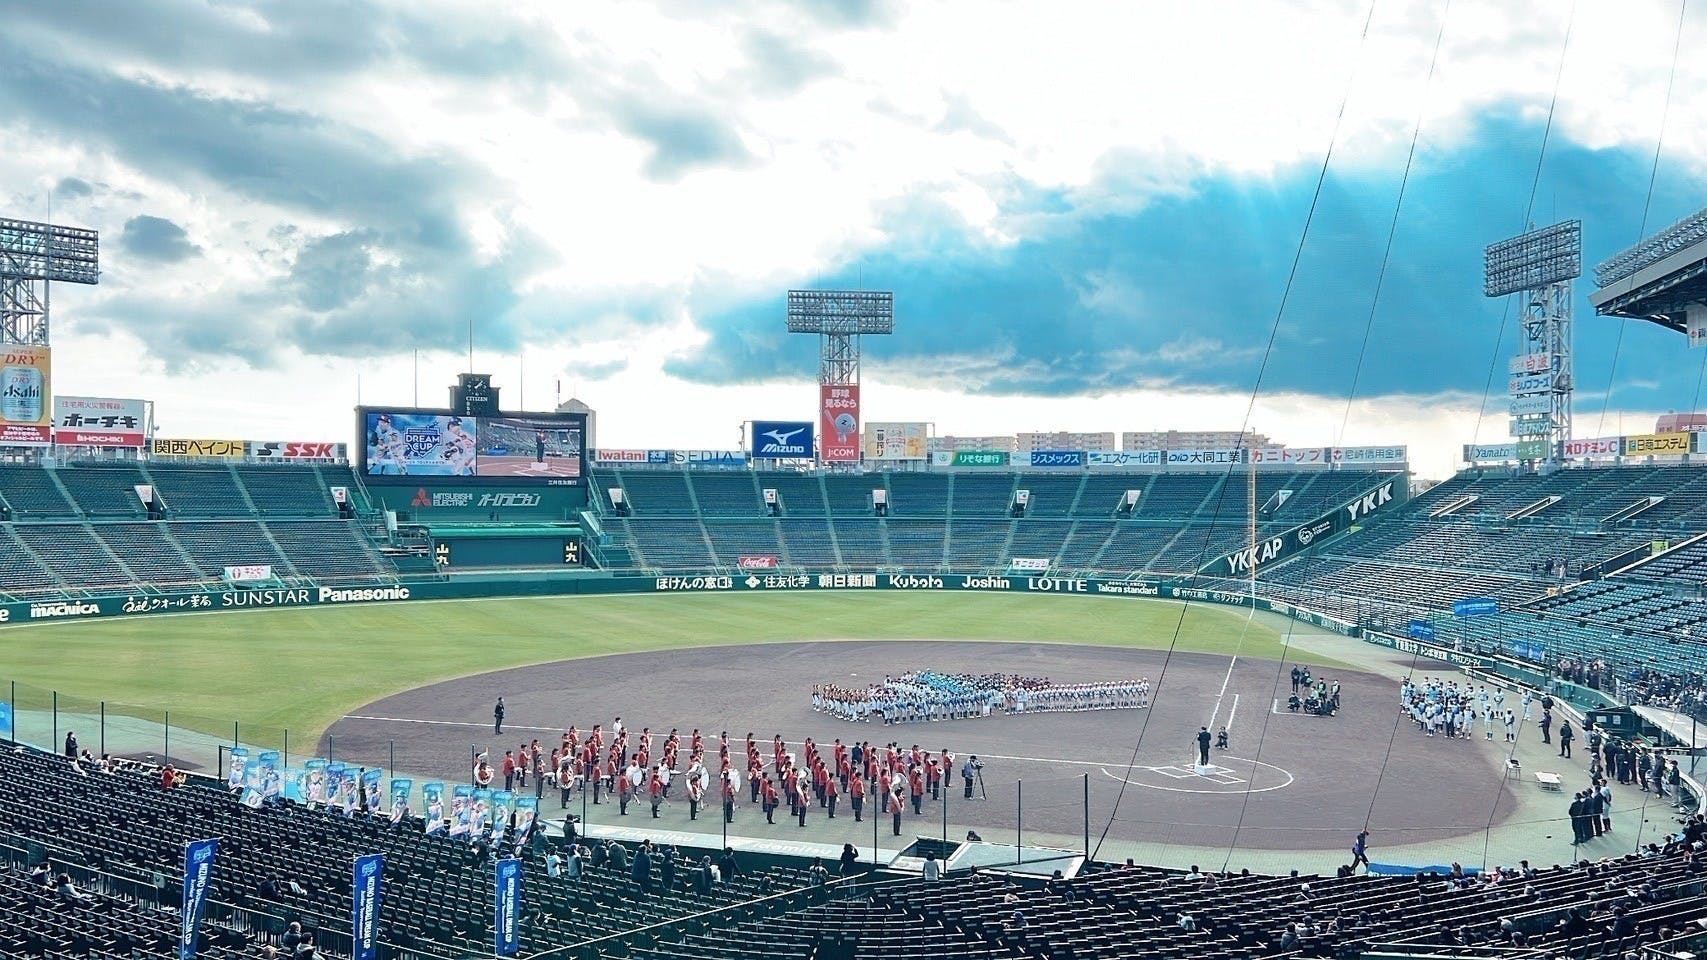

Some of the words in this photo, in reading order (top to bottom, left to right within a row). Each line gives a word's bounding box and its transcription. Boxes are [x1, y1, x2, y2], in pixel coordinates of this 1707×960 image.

[5, 354, 39, 366] DRY
[4, 384, 39, 398] Asahi
[832, 389, 850, 398] 野球
[825, 399, 857, 408] 見るなら
[62, 413, 138, 429] ホーチキ
[84, 435, 124, 443] HOCHIKI
[405, 435, 440, 443] DREAM
[1637, 437, 1688, 452] 日商エステム
[154, 439, 242, 456] 関西ペイント
[283, 443, 333, 457] SSK
[413, 443, 433, 451] CUP
[1345, 448, 1404, 460] 尼崎信用金庫
[1564, 441, 1618, 455] オロナミンC
[599, 450, 646, 461] Iwatani
[674, 450, 735, 462] SEDIA
[959, 454, 1000, 464] りそな銀行
[1032, 452, 1080, 464] シスメックス
[1102, 452, 1159, 464] エスケー化研
[1190, 450, 1241, 463] 大同工業
[1347, 483, 1392, 521] YKK
[437, 543, 449, 565] 山九
[566, 541, 577, 562] 山九
[1227, 546, 1261, 574] YKK
[1260, 537, 1283, 563] AP
[656, 576, 728, 590] ほけんの窓口
[763, 575, 809, 588] 住友化学
[818, 575, 876, 588] 朝日新聞
[889, 576, 943, 590] Kubota
[962, 576, 1010, 589] Joshin
[1029, 577, 1087, 591] LOTTE
[318, 585, 410, 602] Panasonic
[1097, 583, 1122, 593] Takara
[1123, 585, 1158, 595] standard
[152, 595, 212, 610] クオール薬局
[222, 589, 310, 606] SUNSTAR
[366, 876, 375, 897] MIZUNO
[507, 877, 515, 896] MIZUNO
